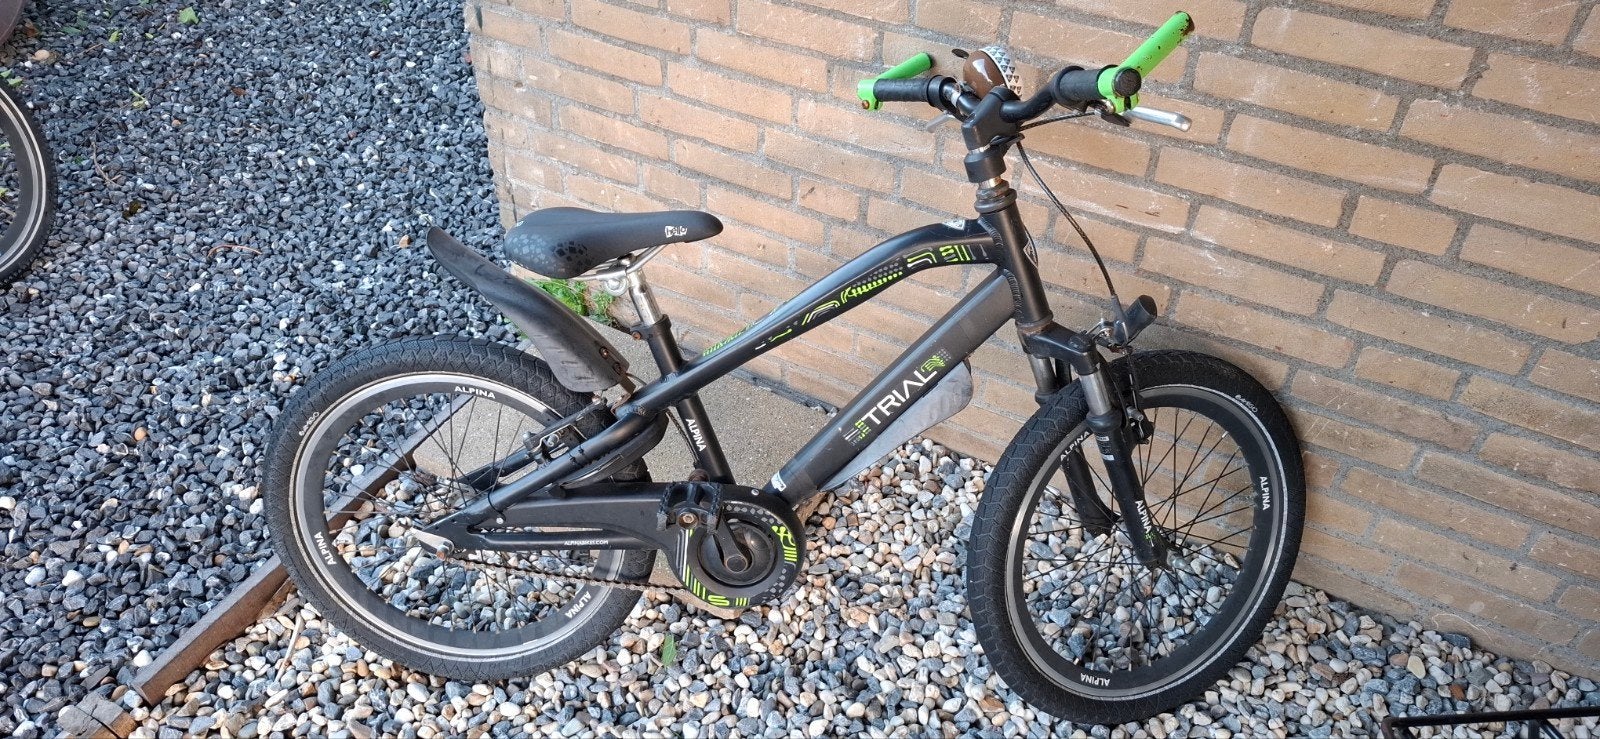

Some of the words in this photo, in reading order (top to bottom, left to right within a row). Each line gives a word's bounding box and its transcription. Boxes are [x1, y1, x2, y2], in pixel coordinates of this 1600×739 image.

[454, 385, 496, 399] ALPINA
[861, 370, 938, 425] TRIAL
[685, 418, 707, 452] ALPINA
[1060, 431, 1090, 461] ALPINA
[1259, 476, 1271, 511] ALPINA
[1135, 500, 1152, 533] ALPINA
[314, 531, 337, 565] ALPINA
[564, 591, 591, 619] ALPINA
[1080, 672, 1110, 687] ALPINA
